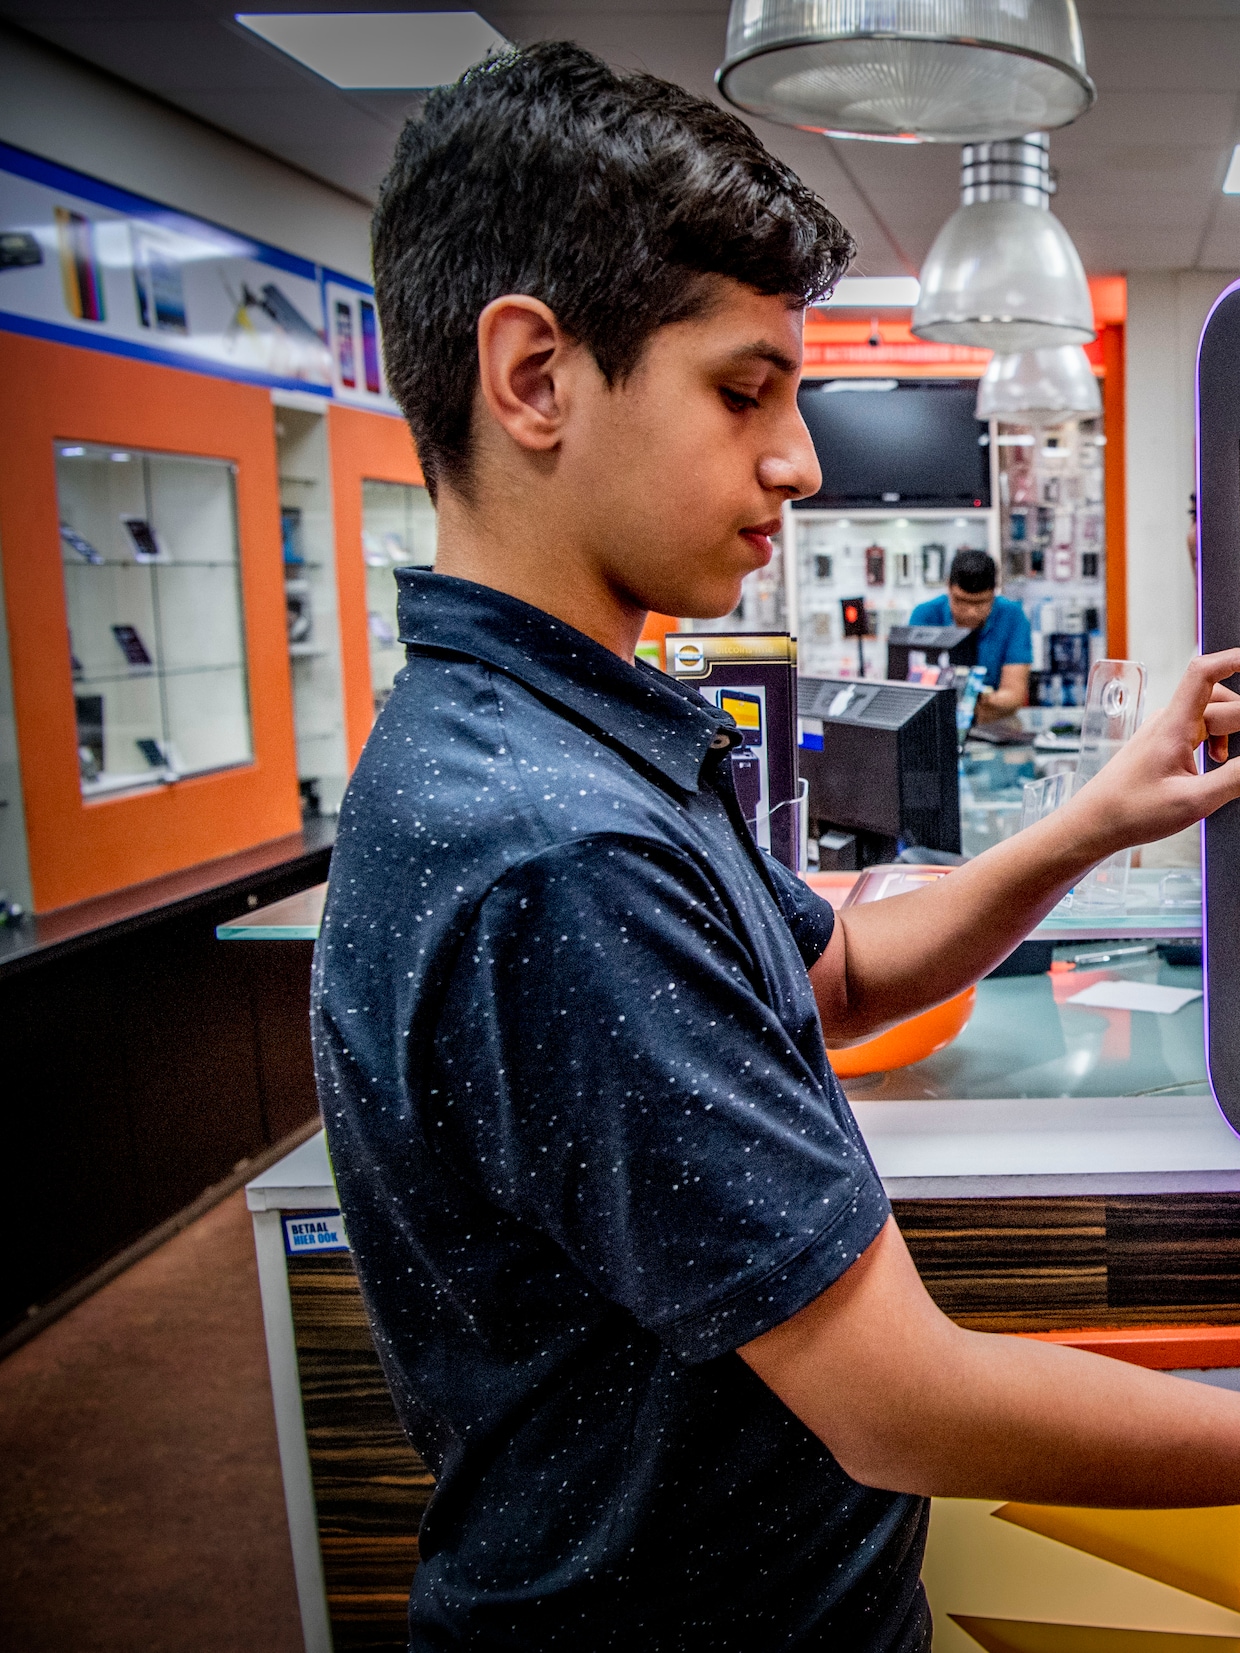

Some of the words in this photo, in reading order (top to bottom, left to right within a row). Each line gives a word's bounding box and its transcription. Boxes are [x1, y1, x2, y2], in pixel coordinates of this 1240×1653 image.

[291, 1222, 328, 1235] BETAAL
[293, 1233, 316, 1246] HIER
[317, 1231, 339, 1244] OOK
